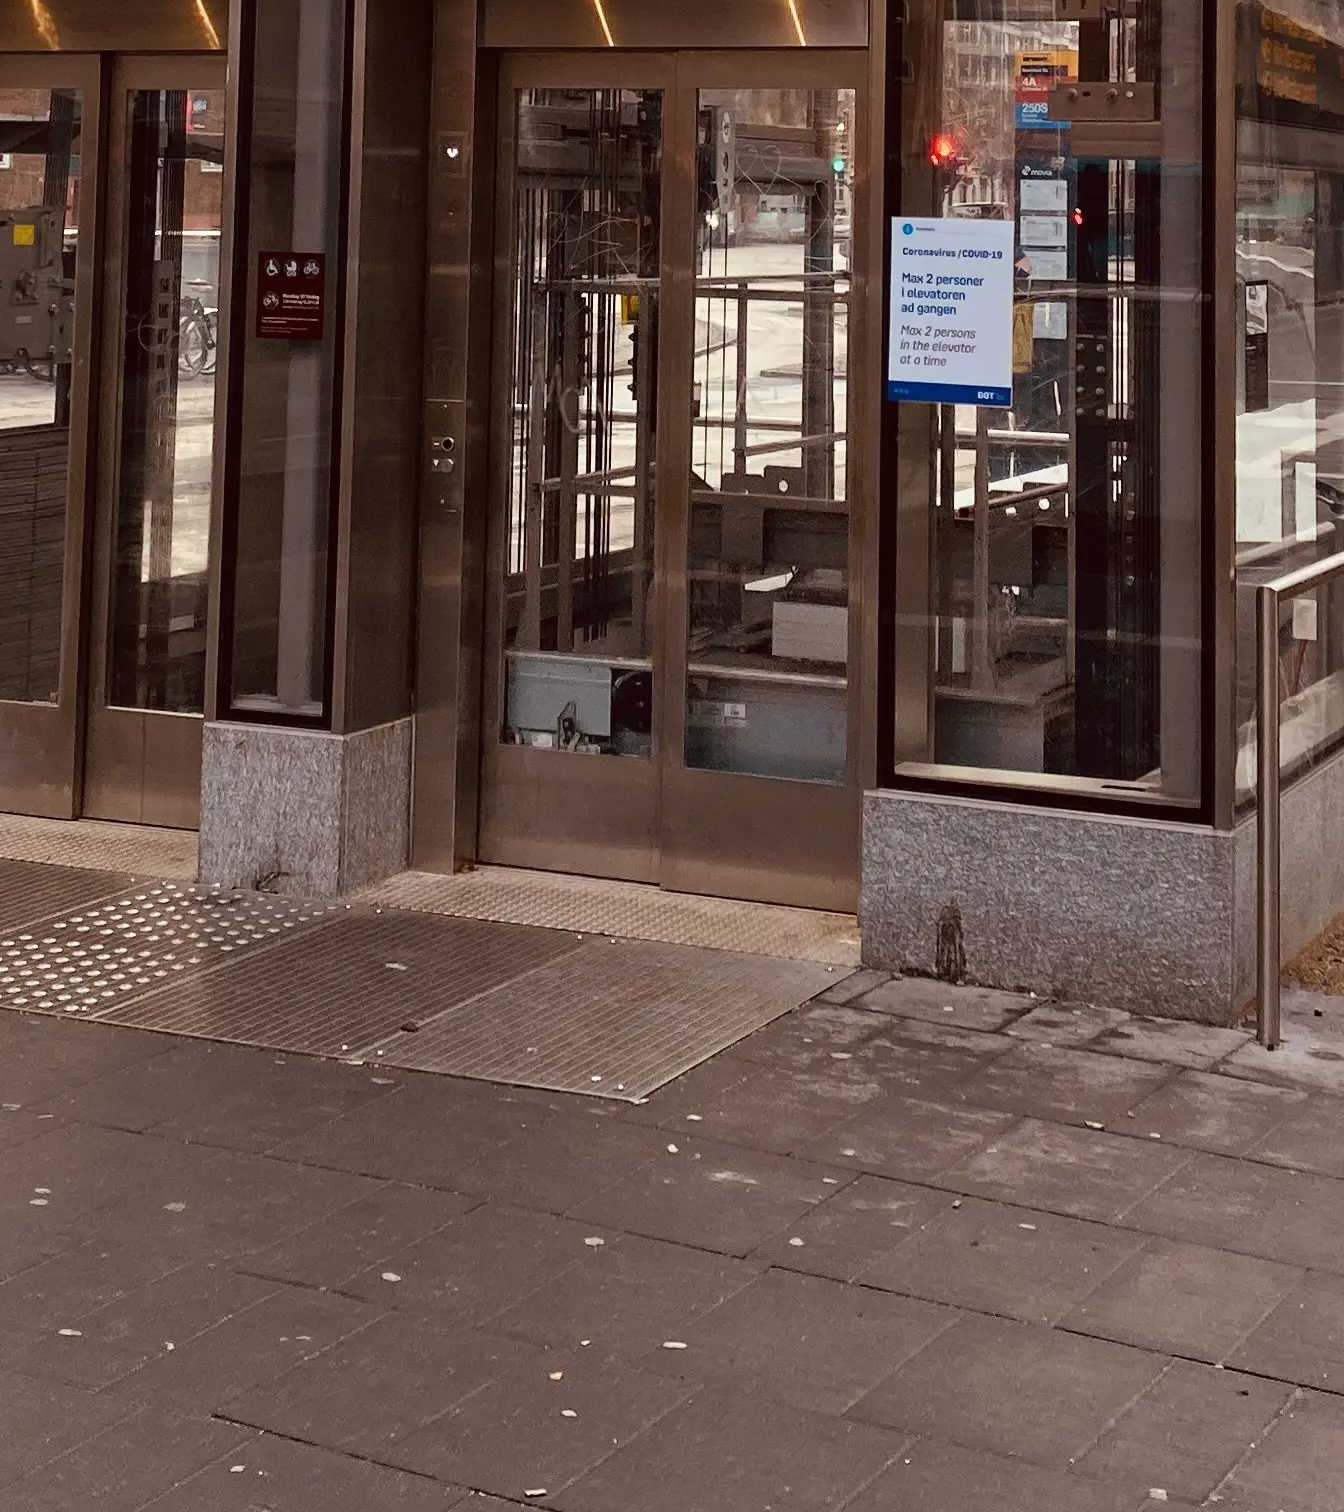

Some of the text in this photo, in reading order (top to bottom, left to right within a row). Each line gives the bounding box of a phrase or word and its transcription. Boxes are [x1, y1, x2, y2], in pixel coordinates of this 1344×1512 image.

[1021, 77, 1037, 87] 4A
[1021, 103, 1048, 113] 250S
[902, 247, 956, 258] Coronavirus
[901, 272, 985, 287] Max 2 personer
[907, 287, 966, 301] elevatoren
[901, 302, 957, 317] ad gangen
[900, 325, 976, 339] Max 2 persons
[900, 339, 976, 354] in the elevator
[899, 355, 947, 367] at a time
[977, 391, 994, 400] DOT
